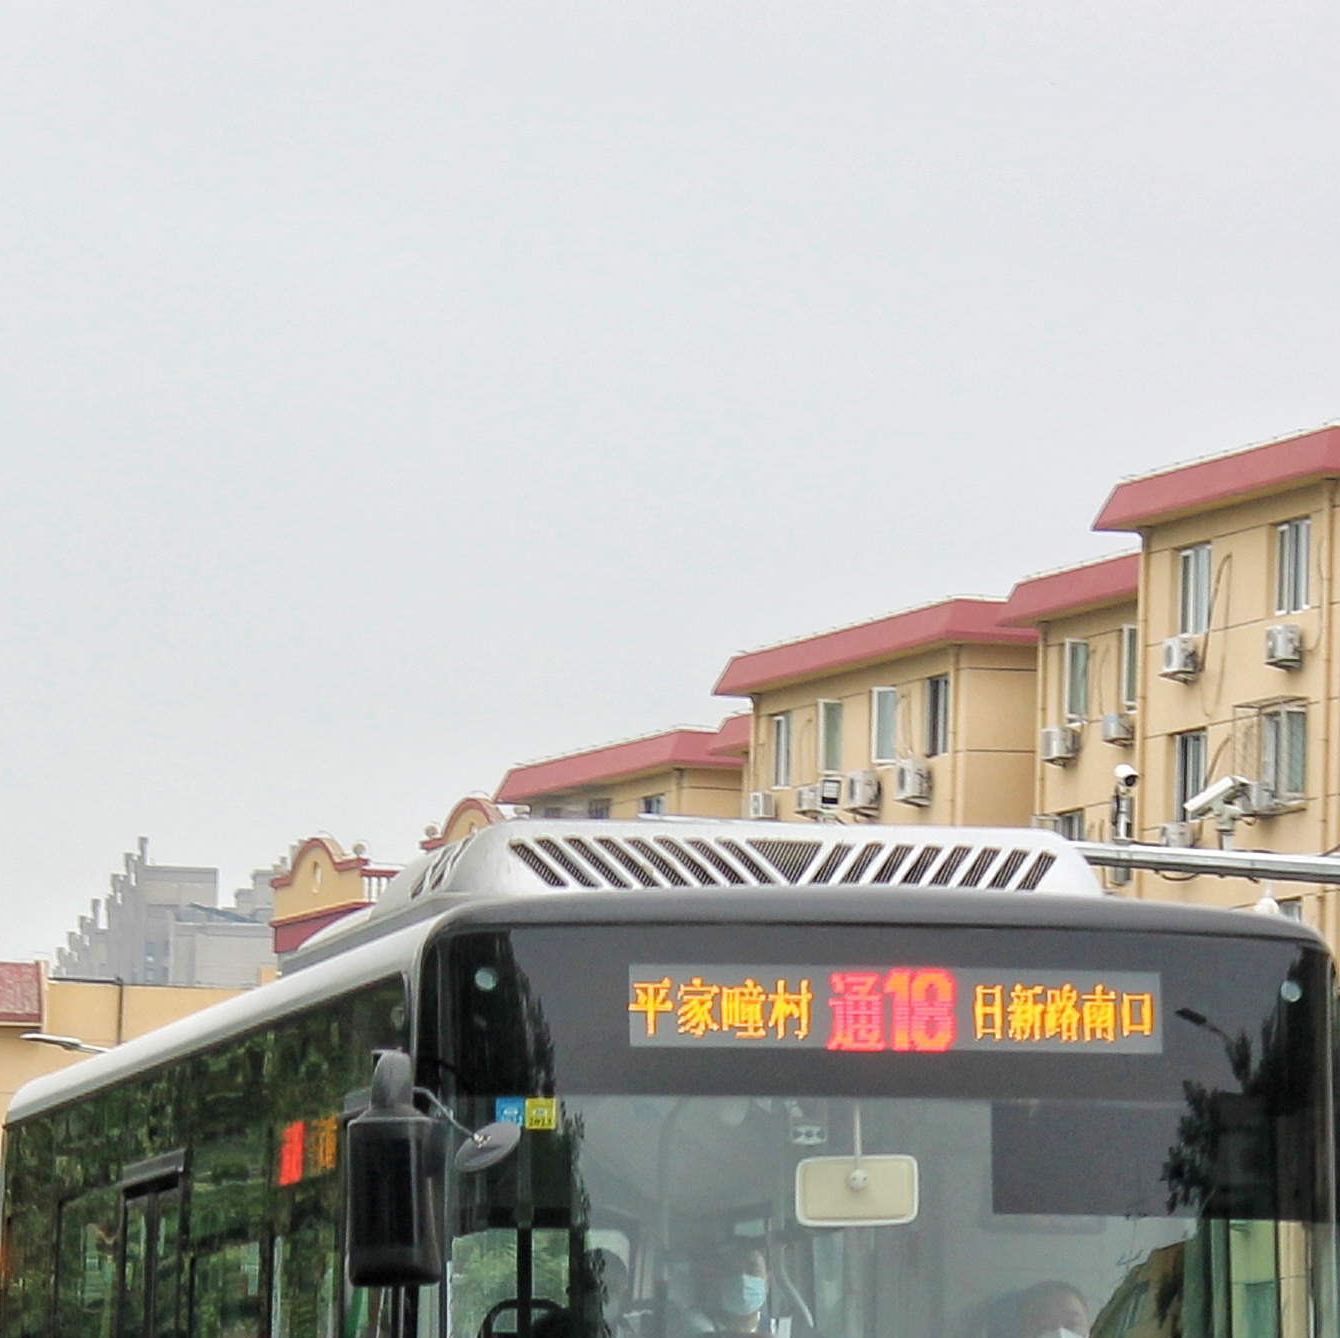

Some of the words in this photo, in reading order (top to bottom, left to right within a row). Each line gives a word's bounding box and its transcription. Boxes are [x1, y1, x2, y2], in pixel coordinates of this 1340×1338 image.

[826, 967, 957, 1052] 通18
[973, 982, 1155, 1042] 日新路南口
